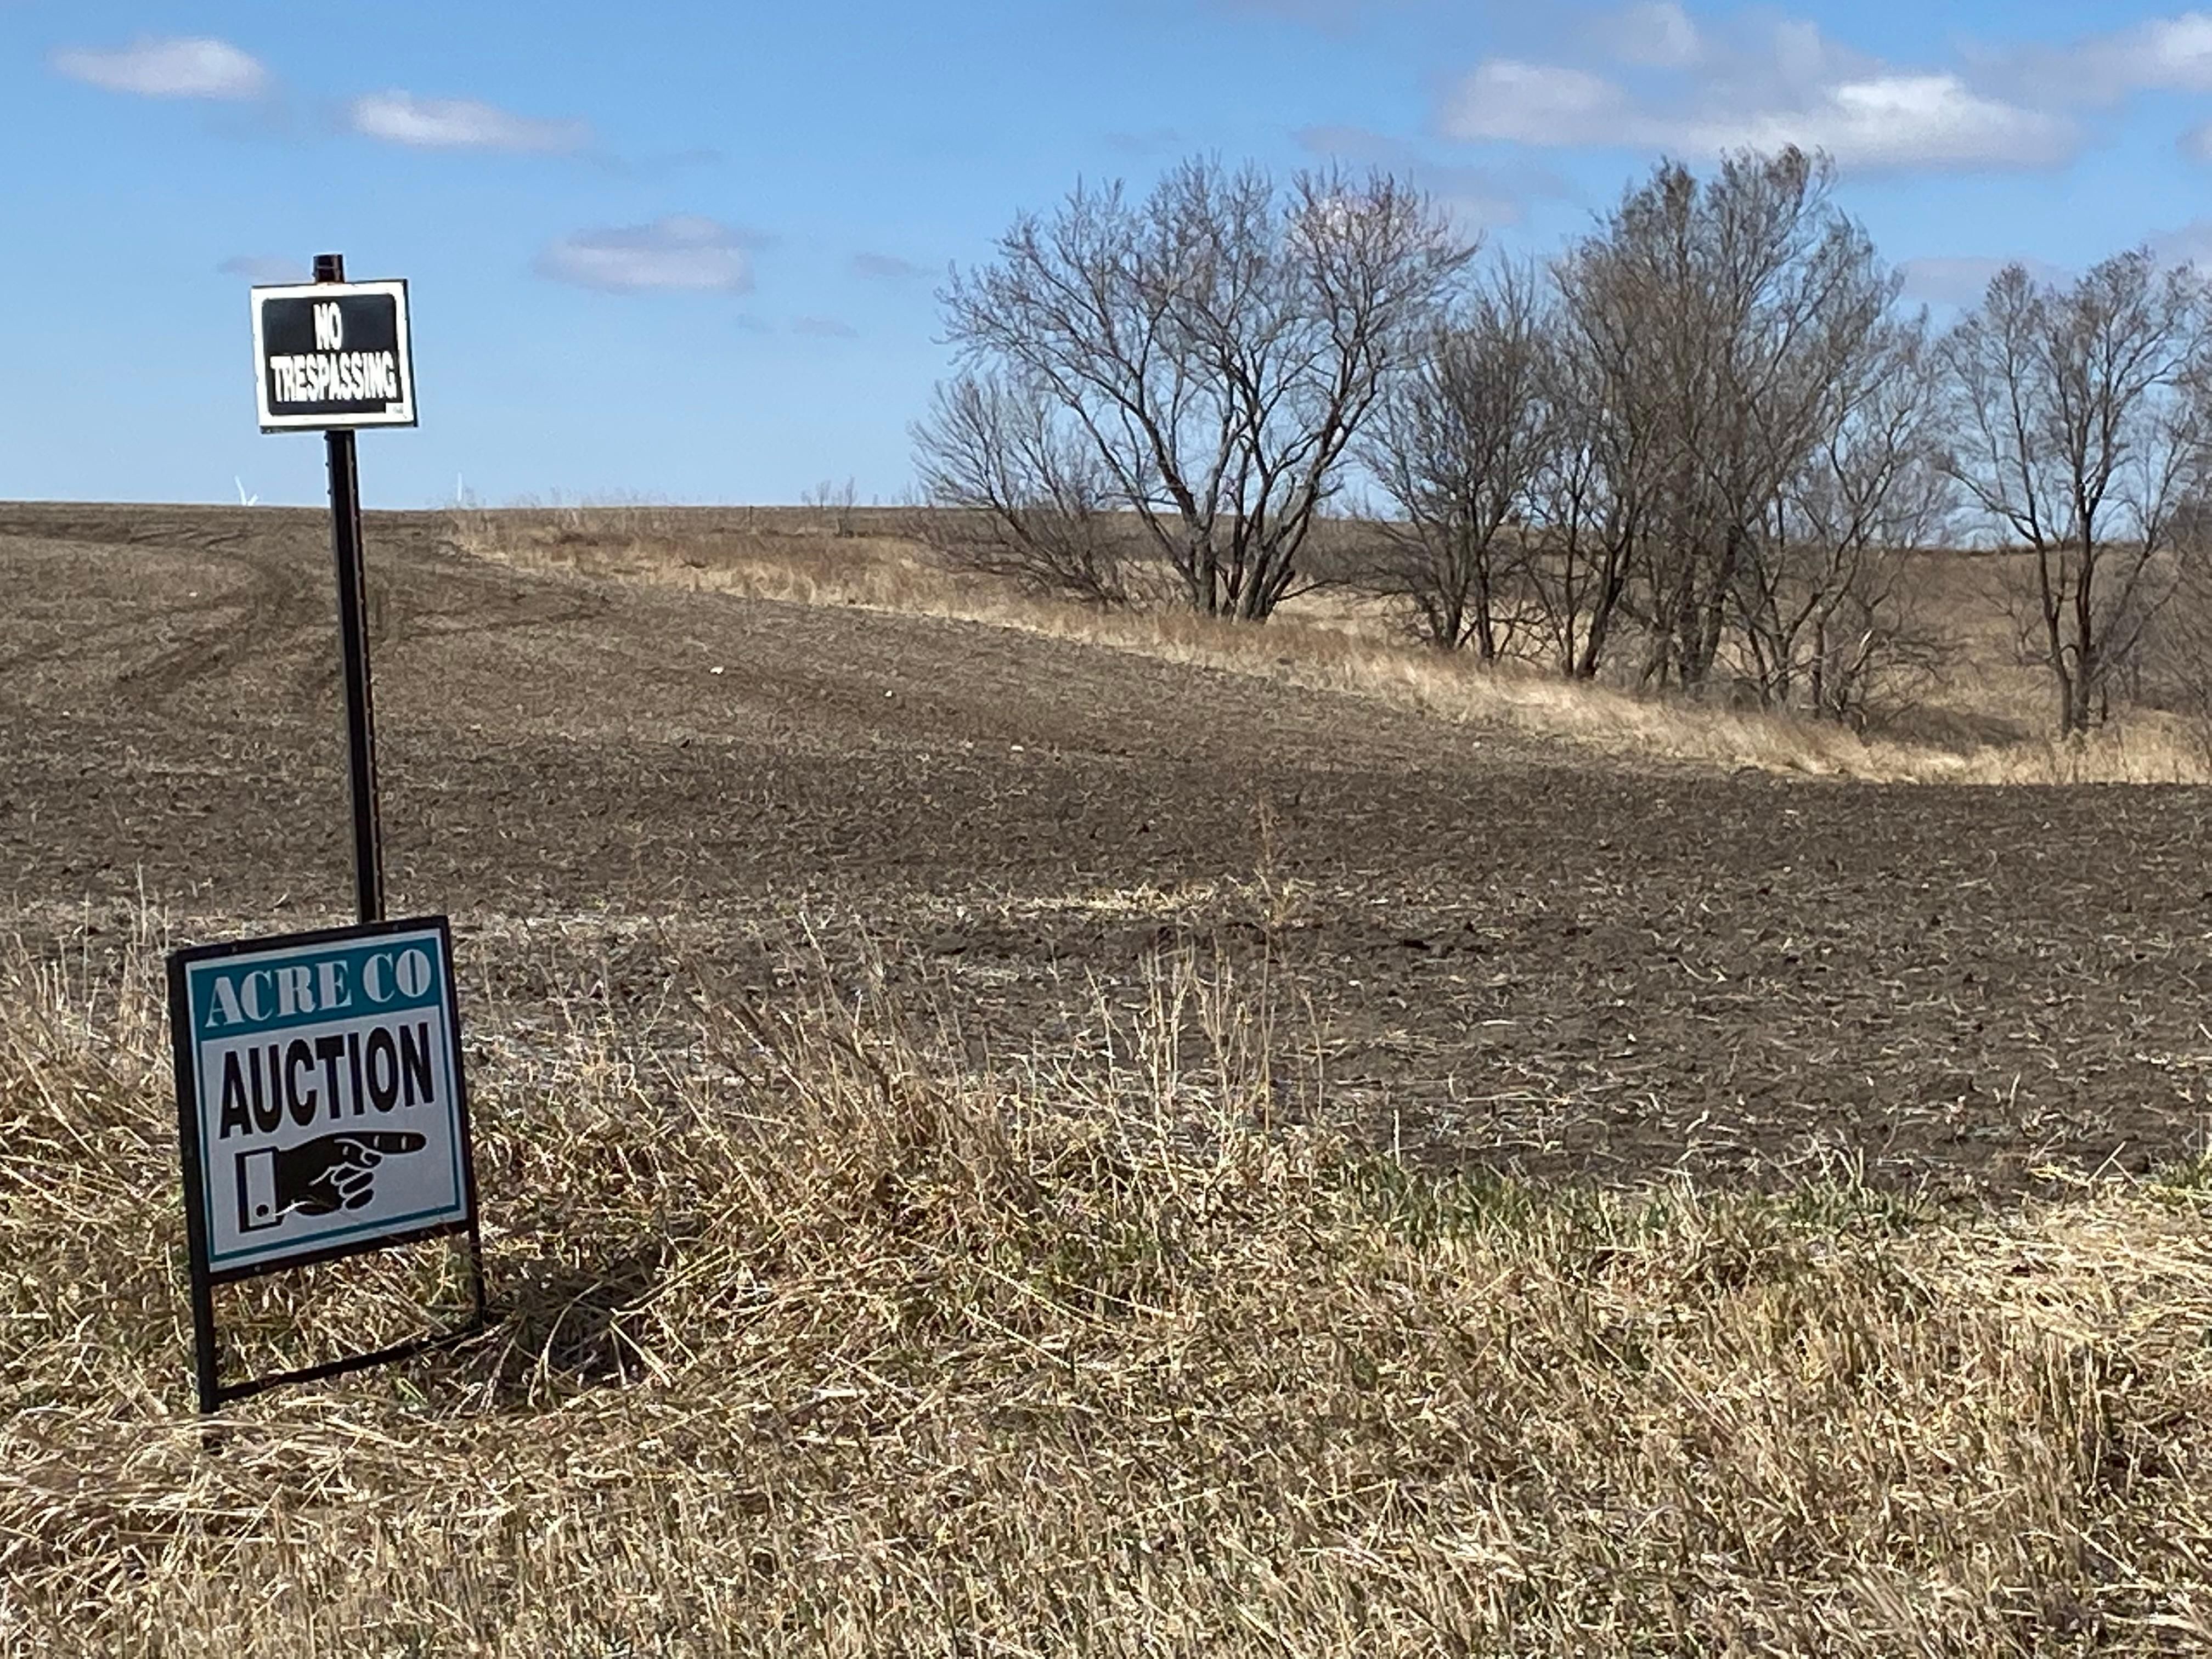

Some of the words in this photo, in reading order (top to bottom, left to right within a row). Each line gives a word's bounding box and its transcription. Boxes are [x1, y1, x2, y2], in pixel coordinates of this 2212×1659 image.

[313, 302, 342, 350] NO
[270, 351, 397, 402] TRESPASSING
[205, 960, 352, 1028] ACRE
[363, 949, 432, 1003] CO
[219, 1023, 434, 1139] AUCTION
